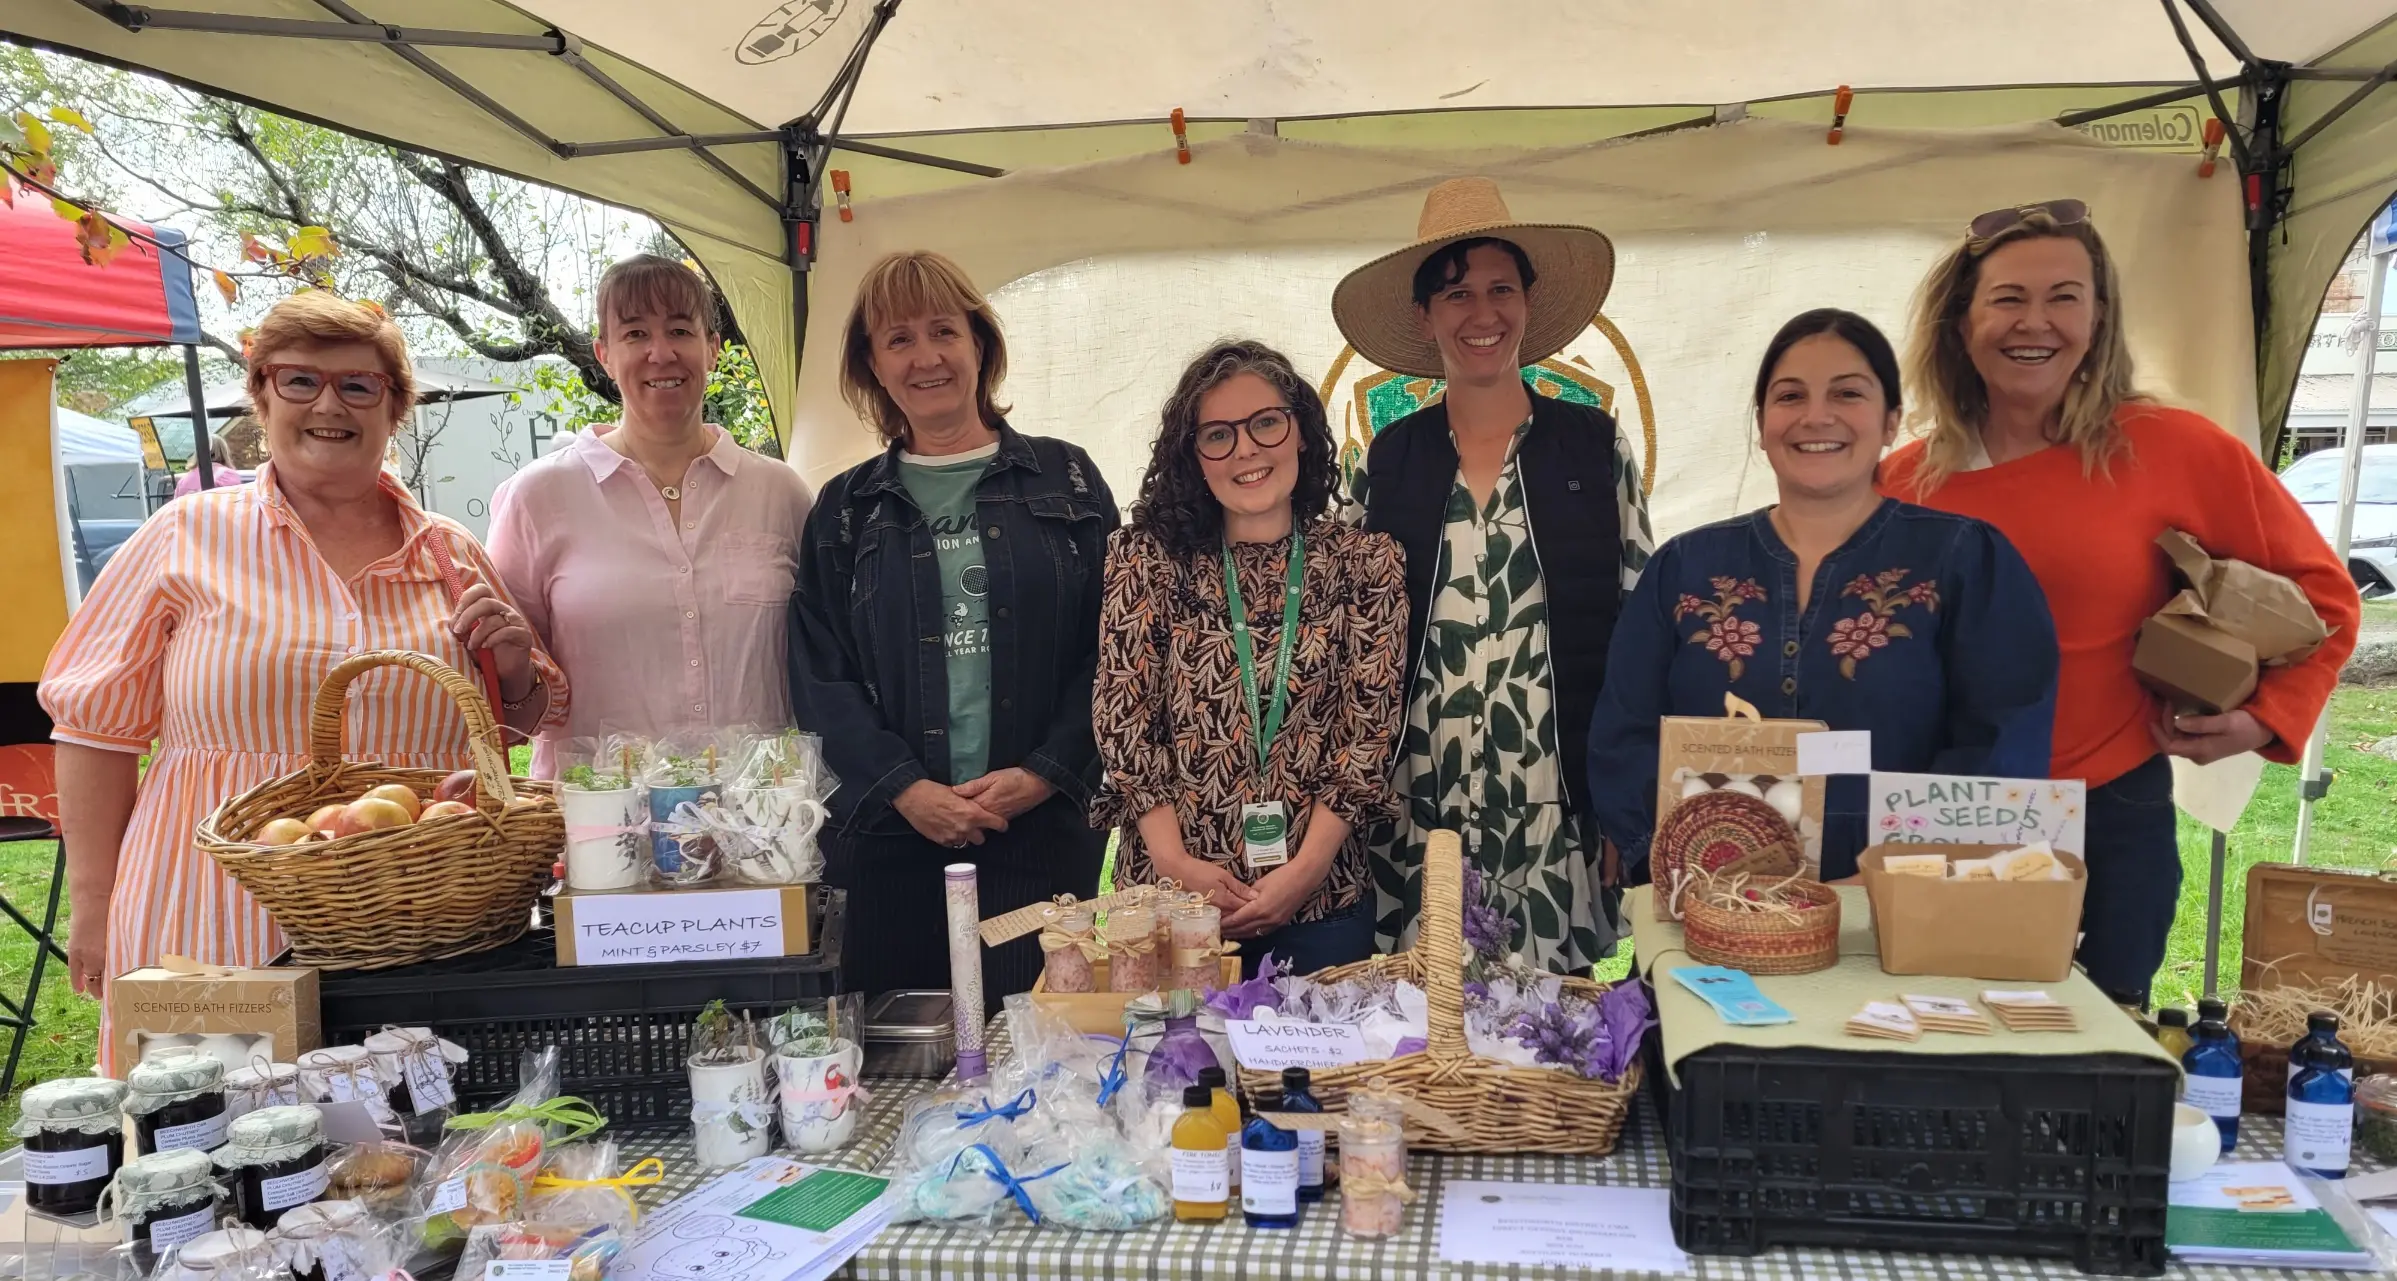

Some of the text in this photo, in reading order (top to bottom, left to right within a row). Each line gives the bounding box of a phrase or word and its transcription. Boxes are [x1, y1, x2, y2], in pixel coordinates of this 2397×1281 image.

[933, 538, 960, 550] ION
[954, 646, 977, 656] YEAR
[1274, 674, 1282, 697] COUNTRY
[1681, 742, 1732, 756] SCENTED
[1735, 744, 1764, 756] BATH
[1885, 781, 2001, 812] PLANT
[581, 915, 778, 938] TEACUP PLANTS
[601, 946, 645, 958] MINT
[661, 941, 736, 957] PARSLEY
[740, 940, 763, 954] $7
[133, 1002, 272, 1014] SCENTED BATH FIZZERS
[1243, 1023, 1350, 1039] LAVENDER
[1265, 1044, 1320, 1055] SACHETS
[1328, 1046, 1343, 1056] $2
